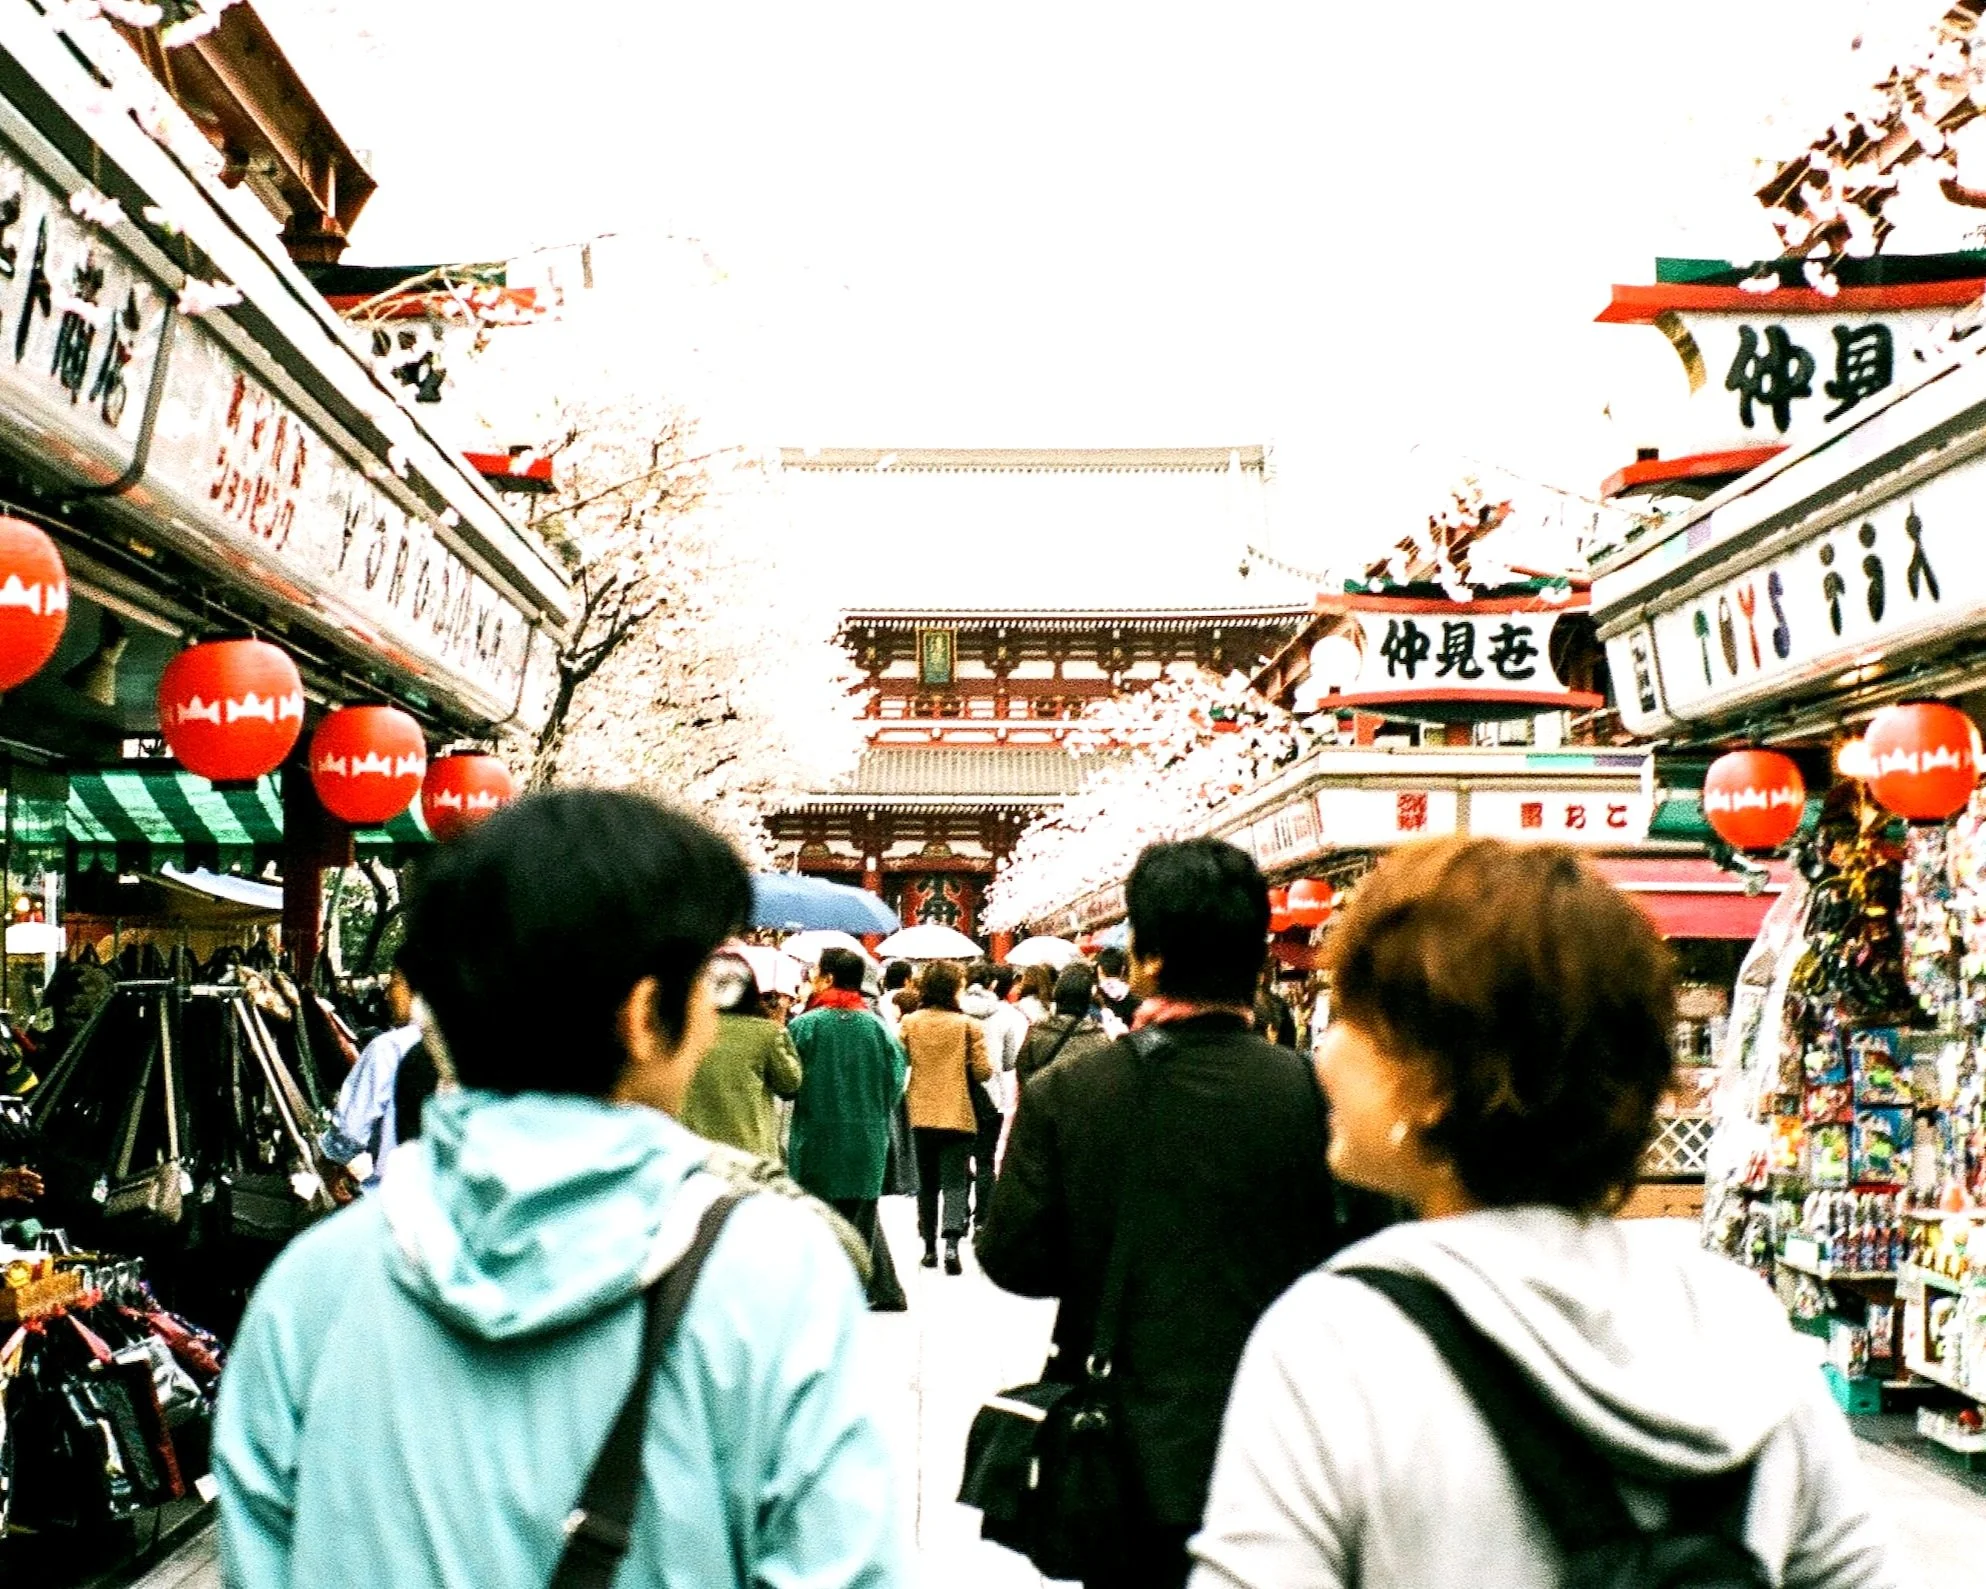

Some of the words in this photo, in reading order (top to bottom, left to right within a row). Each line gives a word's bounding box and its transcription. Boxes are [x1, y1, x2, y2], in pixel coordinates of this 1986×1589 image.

[1380, 619, 1539, 680] 仲見世
[1693, 571, 1791, 686] TOYS
